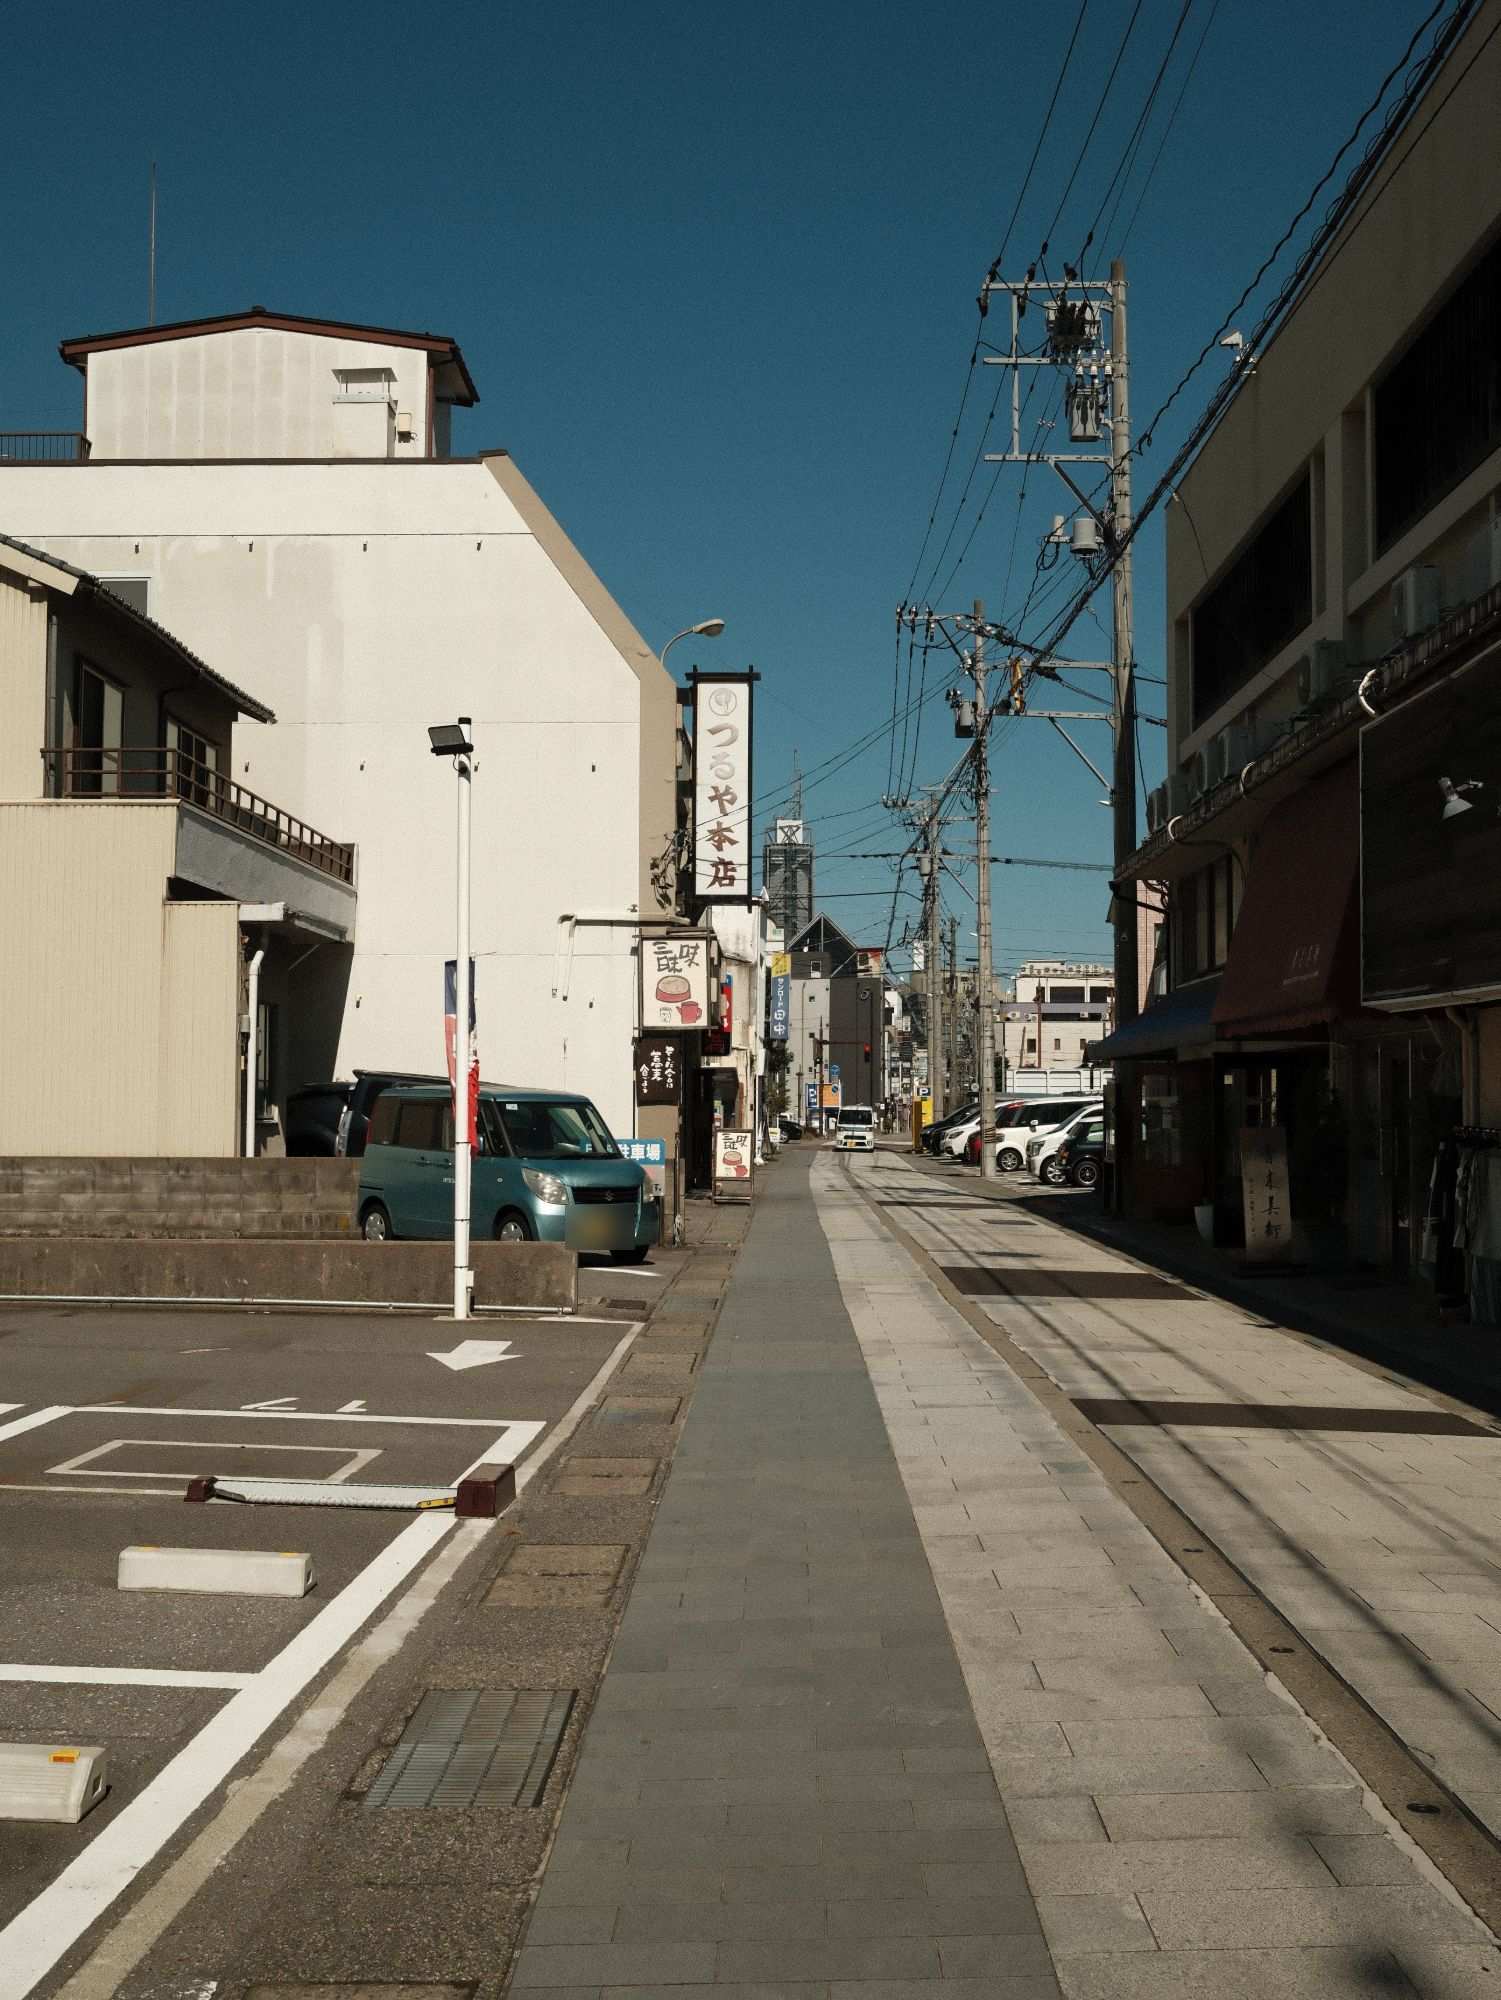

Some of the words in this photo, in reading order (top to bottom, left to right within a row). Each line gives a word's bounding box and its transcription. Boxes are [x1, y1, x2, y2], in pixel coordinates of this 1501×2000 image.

[706, 722, 739, 889] つるや本店
[919, 1088, 929, 1096] P
